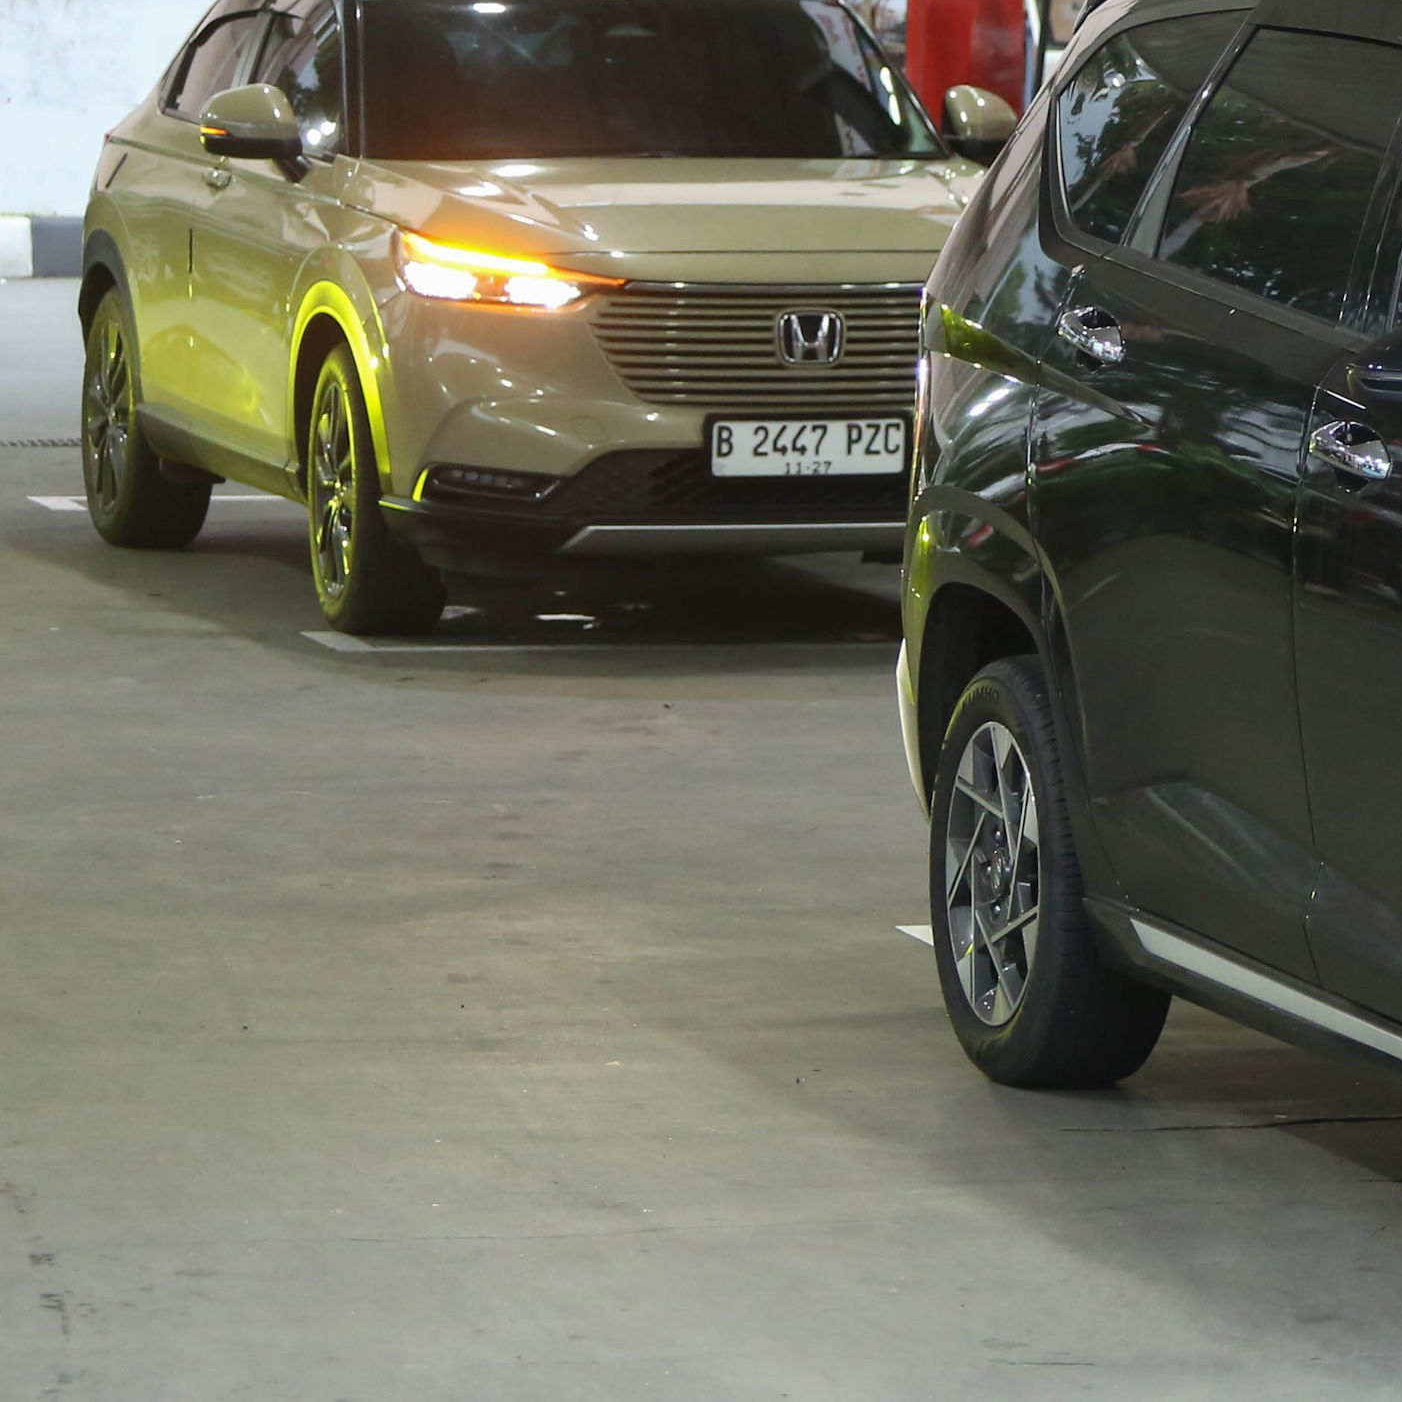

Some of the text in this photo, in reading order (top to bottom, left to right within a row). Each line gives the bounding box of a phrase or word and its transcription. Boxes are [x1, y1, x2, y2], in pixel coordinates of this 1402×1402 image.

[716, 422, 901, 459] B 2447 PZC
